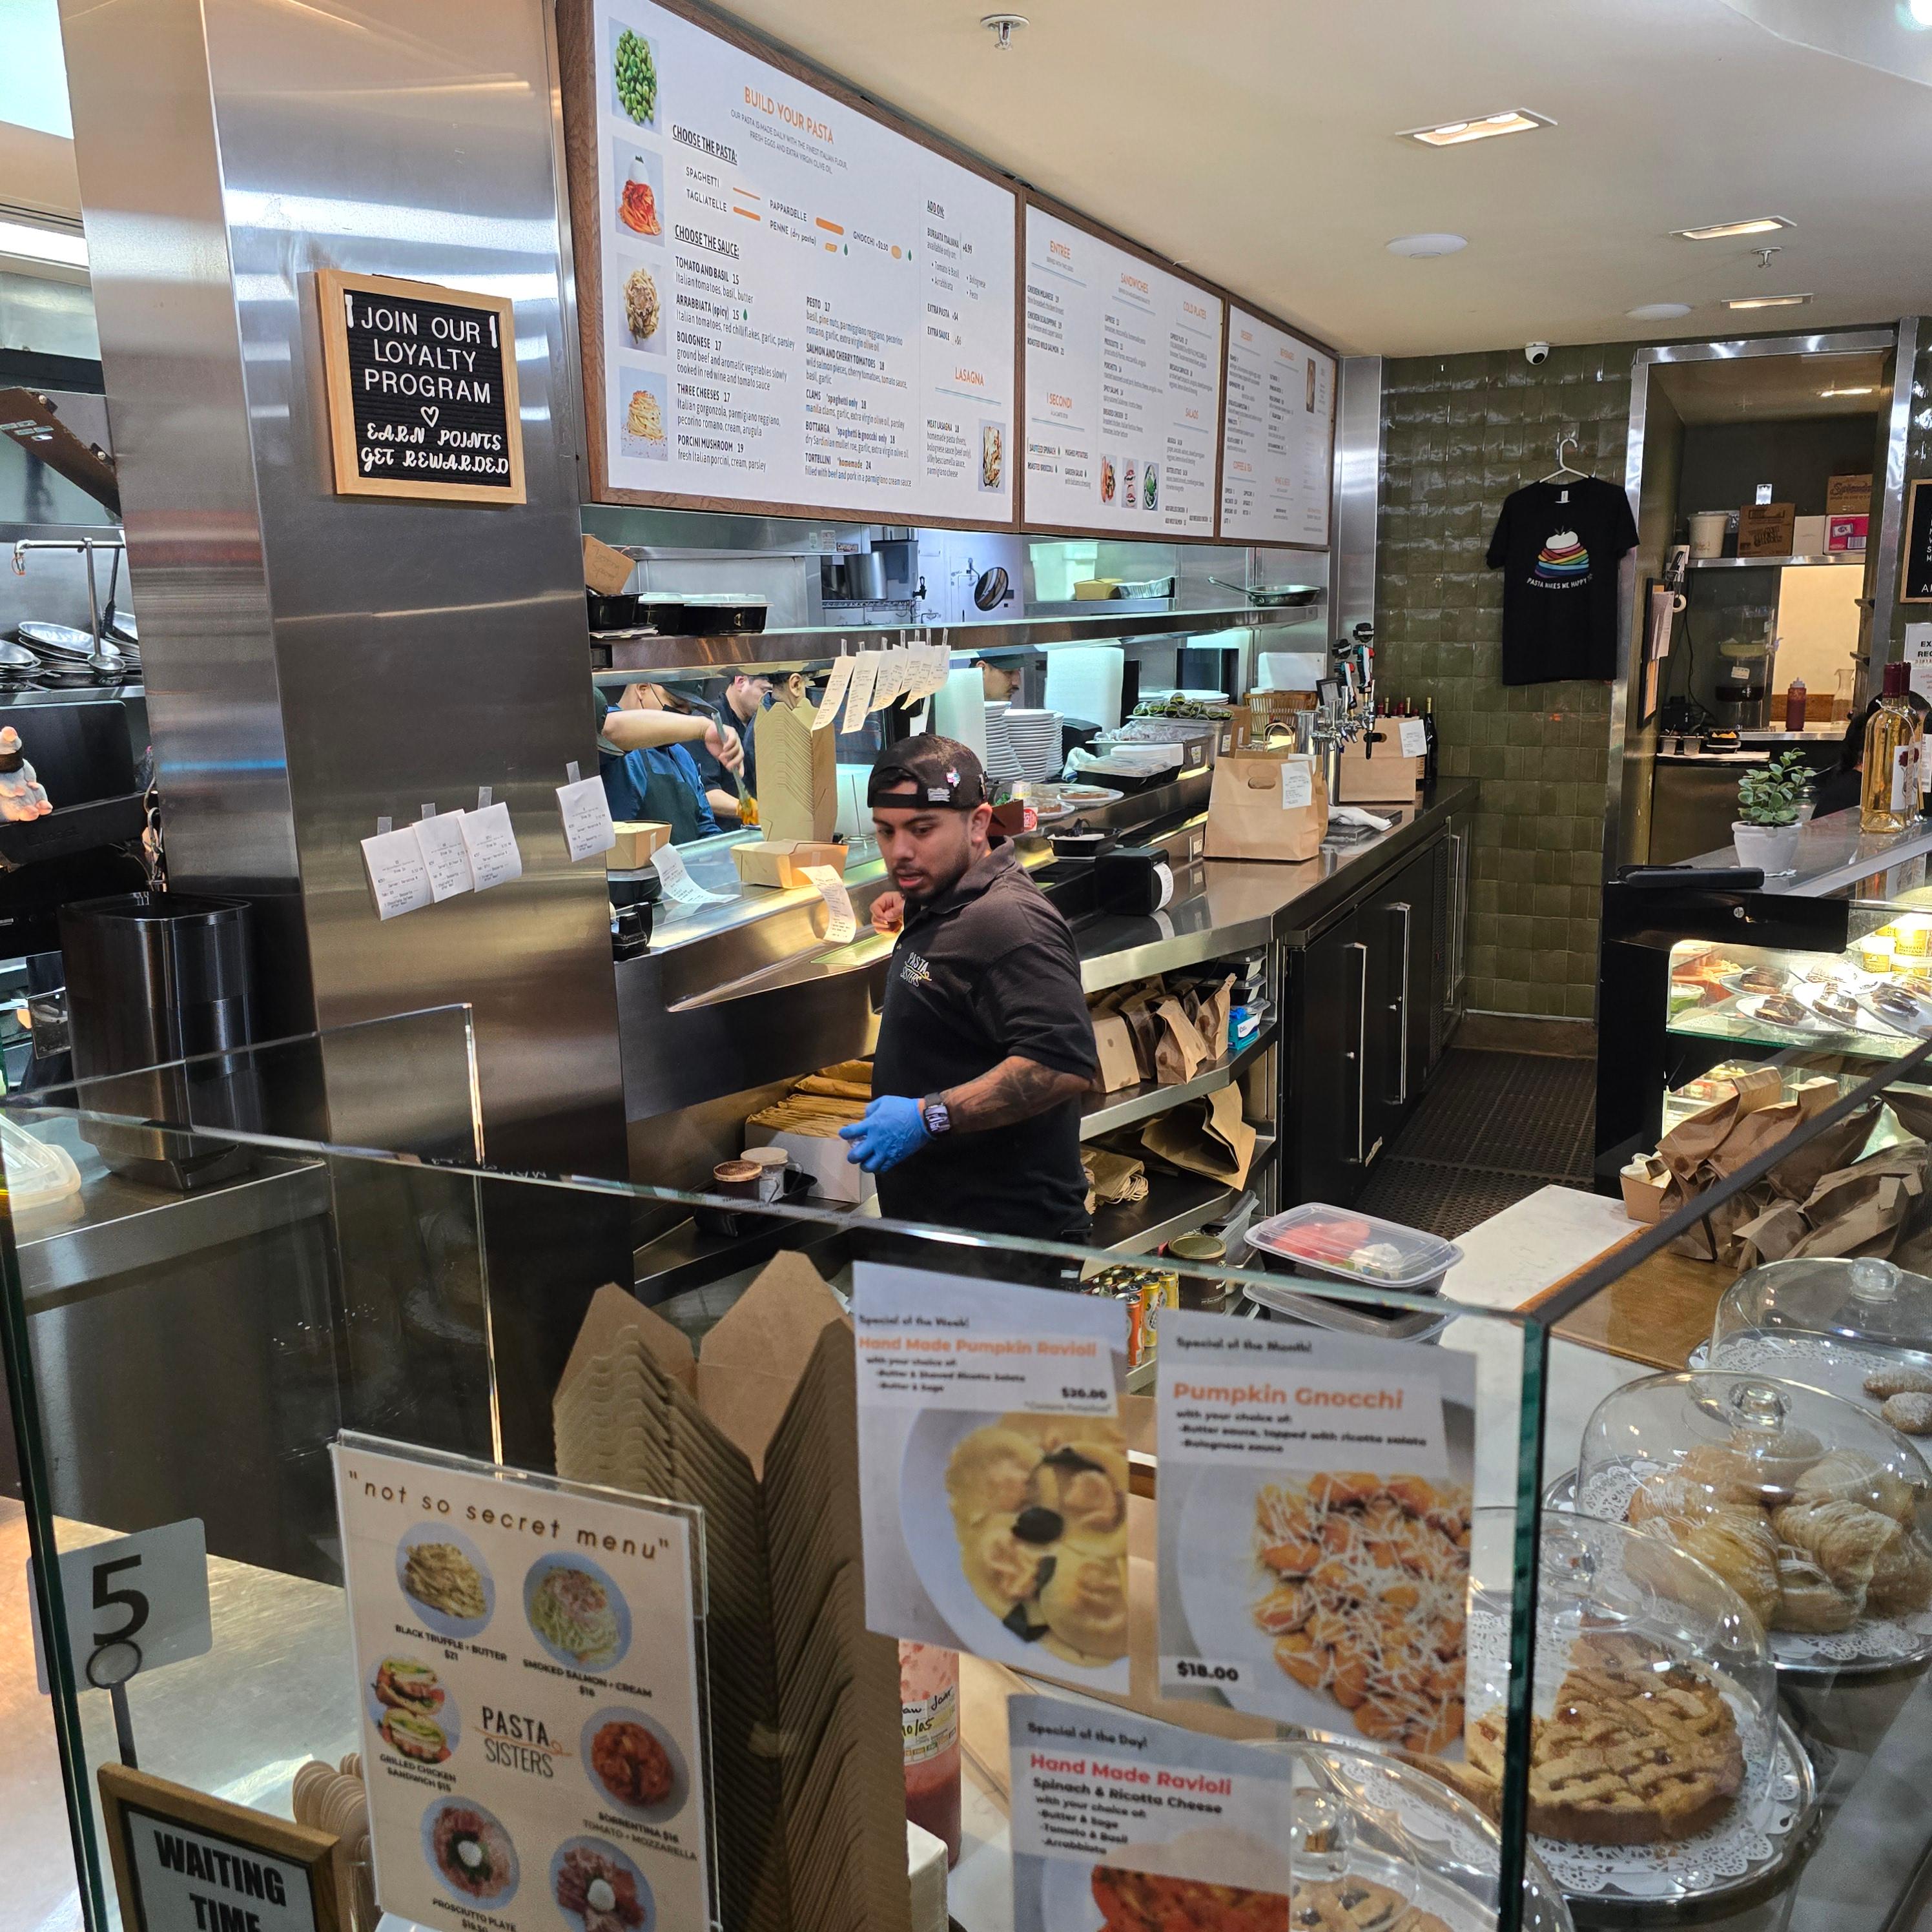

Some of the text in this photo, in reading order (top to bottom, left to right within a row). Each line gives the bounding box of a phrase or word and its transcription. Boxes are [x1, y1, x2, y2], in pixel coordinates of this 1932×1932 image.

[745, 85, 834, 145] BUILD YOUR PASTA
[672, 123, 737, 163] CHOOSE THE PASTA:
[686, 167, 719, 188] SPAGHETTI
[687, 189, 727, 212] TAGLIATELLE
[770, 200, 807, 221] PAPPARDELLE
[927, 200, 936, 213] ADD
[675, 223, 739, 258] CHOOSE THE SAUCE:
[770, 220, 817, 247] PENNE (dry pasta)
[675, 256, 739, 285] TOMATO AND BASIL 15
[1121, 272, 1149, 294] SANDWICHES
[676, 271, 754, 304] Italian tomatoes, basil, butter
[676, 294, 739, 320] ARRABBIATA (spicy) 15
[807, 296, 830, 312] PESTO 17
[361, 307, 480, 344] JOIN OUR
[677, 331, 722, 351] BOLOGNESE 17
[374, 339, 476, 372] LOYALTY
[677, 346, 787, 382] ground beef and aromatic vegetables slowly
[806, 342, 885, 371] SALMON AND CHERRY TOMATOES 18
[365, 369, 490, 404] PROGRAM
[955, 366, 984, 386] LASAGNA
[677, 383, 730, 402] THREE CHEESES 17
[1049, 393, 1073, 409] SECONDI
[677, 398, 780, 427] Italian gorgonzola, parmigiano reggiano,
[927, 418, 960, 433] MEAT LASAGNA 18
[367, 423, 502, 450] EARN POINTS
[677, 435, 744, 453] PORCINI MUSHROOM 19
[361, 447, 508, 474] GET REWARDED
[1526, 577, 1543, 588] PASTA
[1571, 578, 1587, 587] HAPPY
[900, 966, 922, 987] SISTERS
[907, 952, 929, 974] PASTA
[859, 1315, 898, 1327] Special
[903, 1317, 912, 1326] of
[916, 1317, 932, 1327] the
[859, 1337, 1096, 1356] Hand Made Pumpkin Ravioli
[1177, 1337, 1223, 1350] Special
[1228, 1337, 1238, 1348] of
[1244, 1339, 1262, 1351] the
[1174, 1382, 1404, 1410] Pumpkin Gnocchi
[422, 1495, 449, 1513] so
[466, 1505, 560, 1538] secret
[92, 1554, 149, 1646] 5
[395, 1624, 424, 1639] BLACK
[425, 1632, 464, 1650] TRUFFLE
[471, 1645, 507, 1661] BUTTER
[523, 1659, 564, 1676] SMOKED
[566, 1670, 607, 1688] SALMON
[615, 1681, 652, 1698] CREAM
[1177, 1660, 1239, 1681] $18.00
[482, 1705, 549, 1747] PASTA
[1029, 1722, 1147, 1751] Special of the Day!
[380, 1753, 456, 1783] GRILLED CHICKEN
[484, 1738, 553, 1778] SISTERS
[387, 1767, 435, 1788] SANDWICH
[1031, 1753, 1231, 1796] Hand Made Ravioli
[1034, 1777, 1222, 1814] Spinach & Ricotta Cheese
[1036, 1795, 1060, 1805] with
[1064, 1799, 1087, 1810] your
[1091, 1803, 1128, 1816] choice
[1080, 1814, 1087, 1824] &
[1091, 1816, 1118, 1829] Sage
[1089, 1830, 1096, 1839] &
[1100, 1831, 1128, 1844] Basil
[154, 1829, 286, 1906] WAITING
[189, 1893, 260, 1932] TIME
[432, 1897, 516, 1932] PROSCIUTTO PLATE
